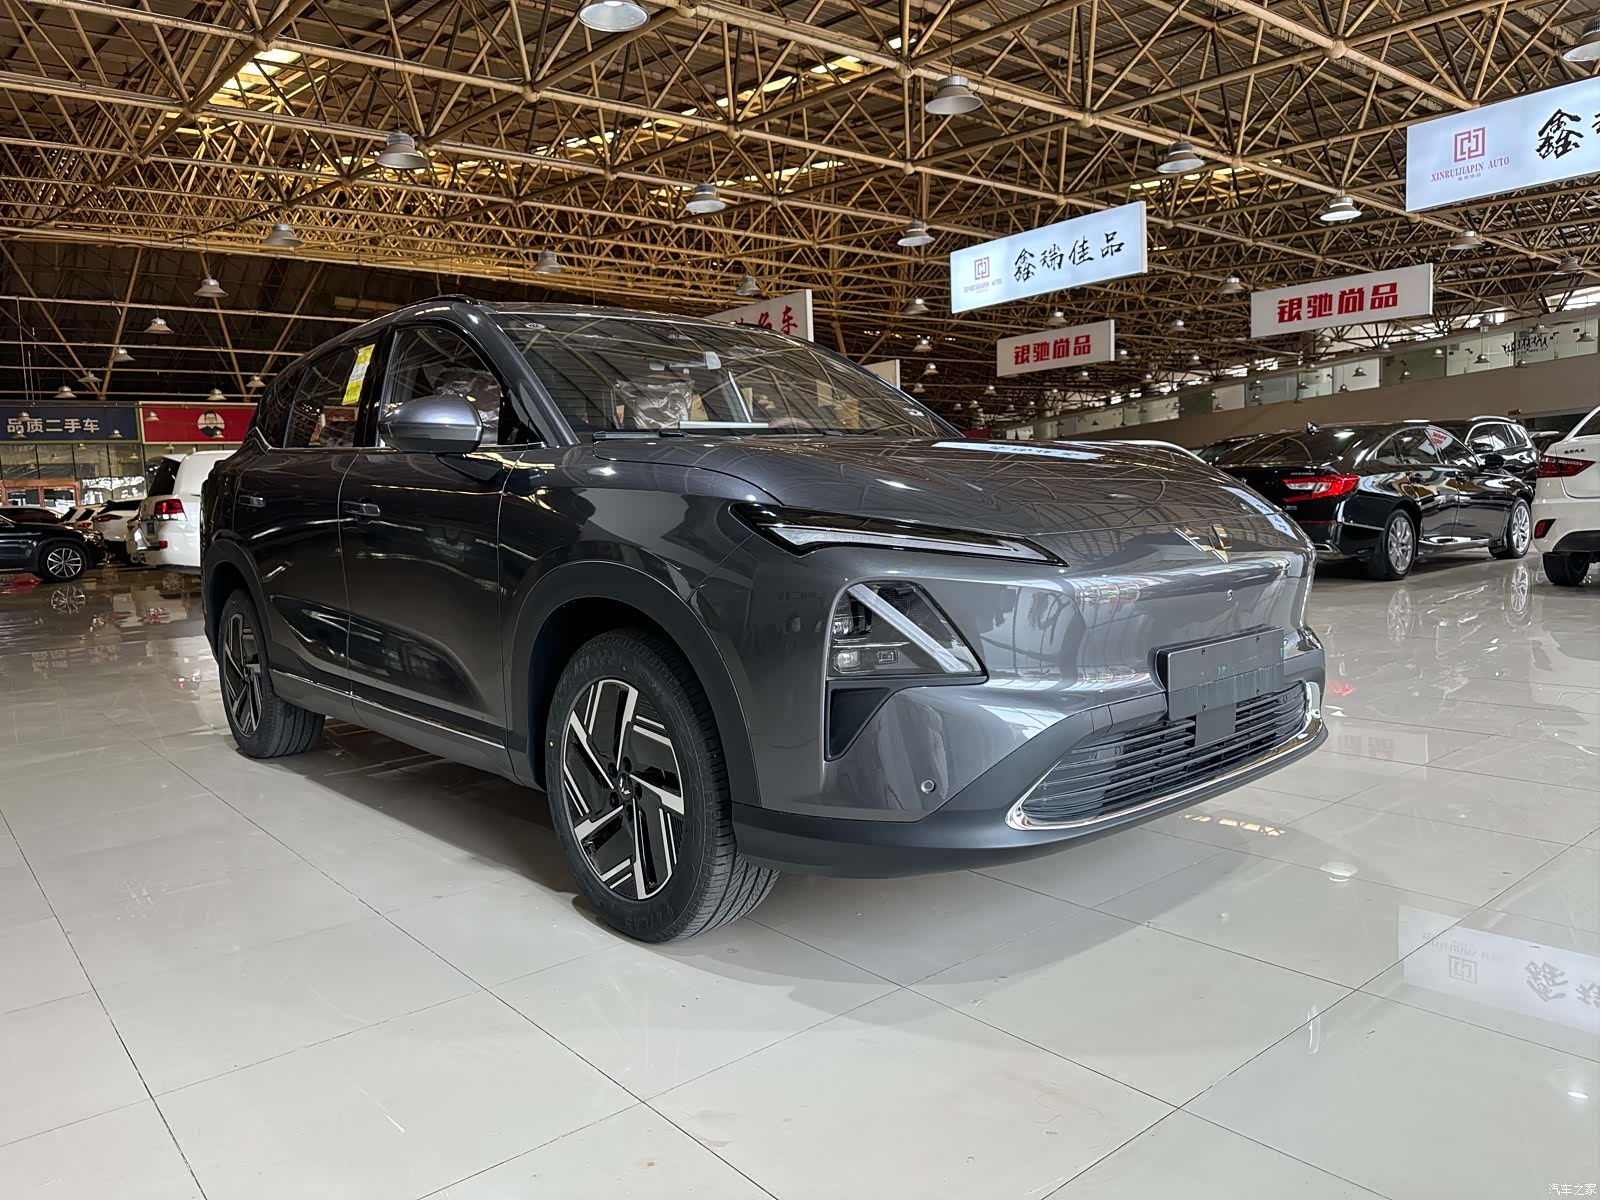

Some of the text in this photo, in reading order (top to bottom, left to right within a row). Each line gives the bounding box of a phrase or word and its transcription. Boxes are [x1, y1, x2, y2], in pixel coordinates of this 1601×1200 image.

[1536, 108, 1600, 159] 鑫
[1431, 162, 1484, 182] XINRUIJIAPIN
[1488, 156, 1510, 169] AUTO
[1014, 231, 1125, 282] 鑫瑞佳品
[1277, 282, 1398, 323] 银驰尚品
[1014, 334, 1091, 365] 银驰尚品
[6, 417, 100, 433] 品质二手车
